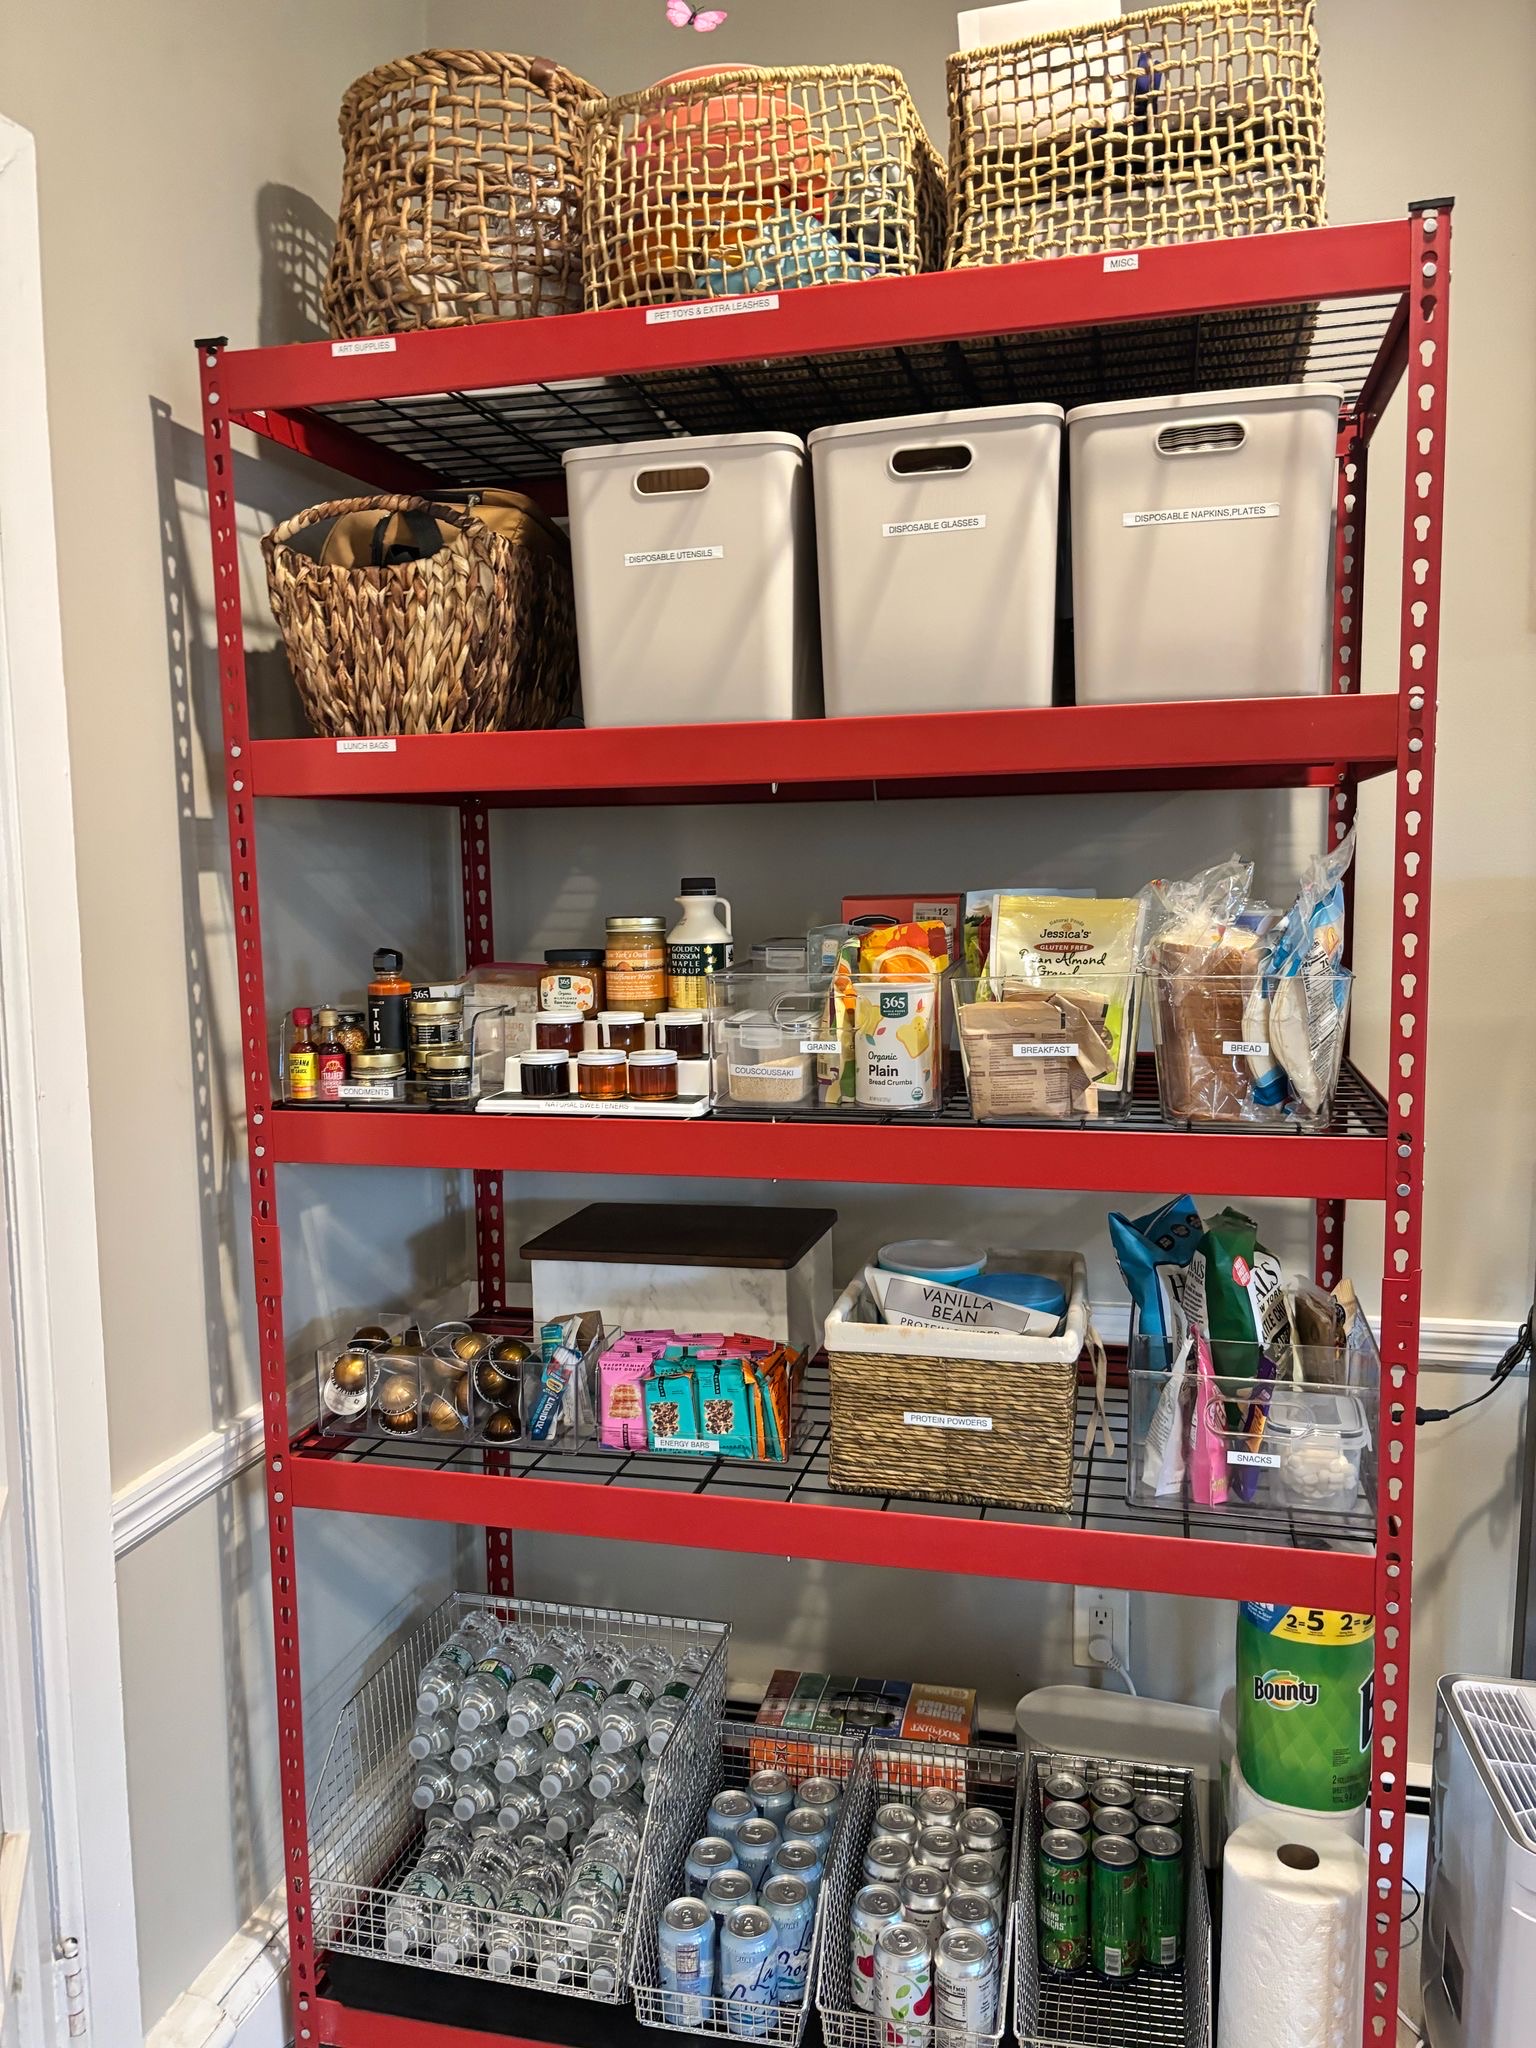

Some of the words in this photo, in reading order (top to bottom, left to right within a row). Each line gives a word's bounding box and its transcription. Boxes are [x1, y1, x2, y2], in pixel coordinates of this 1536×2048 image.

[1110, 258, 1136, 268] MISC.
[654, 312, 670, 320] PET
[672, 308, 694, 318] TOYS
[703, 304, 731, 314] EXTRA
[732, 299, 770, 310] LEASHES
[338, 345, 352, 353] ART
[353, 341, 390, 352] SUPPLIES
[1134, 511, 1189, 523] DISPOSABLE
[888, 522, 939, 534] DISPOSABLE
[941, 518, 979, 529] GLASSES
[628, 552, 676, 564] DISPOSABLE
[676, 549, 713, 560] UTENSILS
[343, 742, 368, 750] LUNCH
[369, 741, 389, 750] BAGS
[1040, 928, 1089, 939] Jessica's
[672, 945, 700, 953] GOLDEN
[1055, 951, 1107, 966] Almond
[672, 967, 701, 975] SYRUP
[412, 990, 429, 1000] 365
[882, 995, 906, 1009] 365
[807, 1043, 837, 1051] GRAINS
[1021, 1046, 1071, 1054] BREAKFAST
[1231, 1044, 1262, 1053] BREAD
[868, 1051, 898, 1063] Organic
[869, 1064, 899, 1077] Plain
[869, 1078, 886, 1086] Bread
[344, 1088, 390, 1096] CONDIMENTS
[580, 1102, 629, 1110] SWEETENERS
[923, 1287, 993, 1311] VANILLA
[932, 1305, 978, 1324] BEAN
[911, 1415, 945, 1424] PROTEIN
[947, 1417, 987, 1427] POWDERS
[660, 1440, 690, 1448] ENERGY
[1237, 1454, 1272, 1464] SNACKS
[1254, 1676, 1317, 1704] Bounty
[910, 1723, 961, 1740] SIXPOINT
[750, 1956, 773, 1991] La
